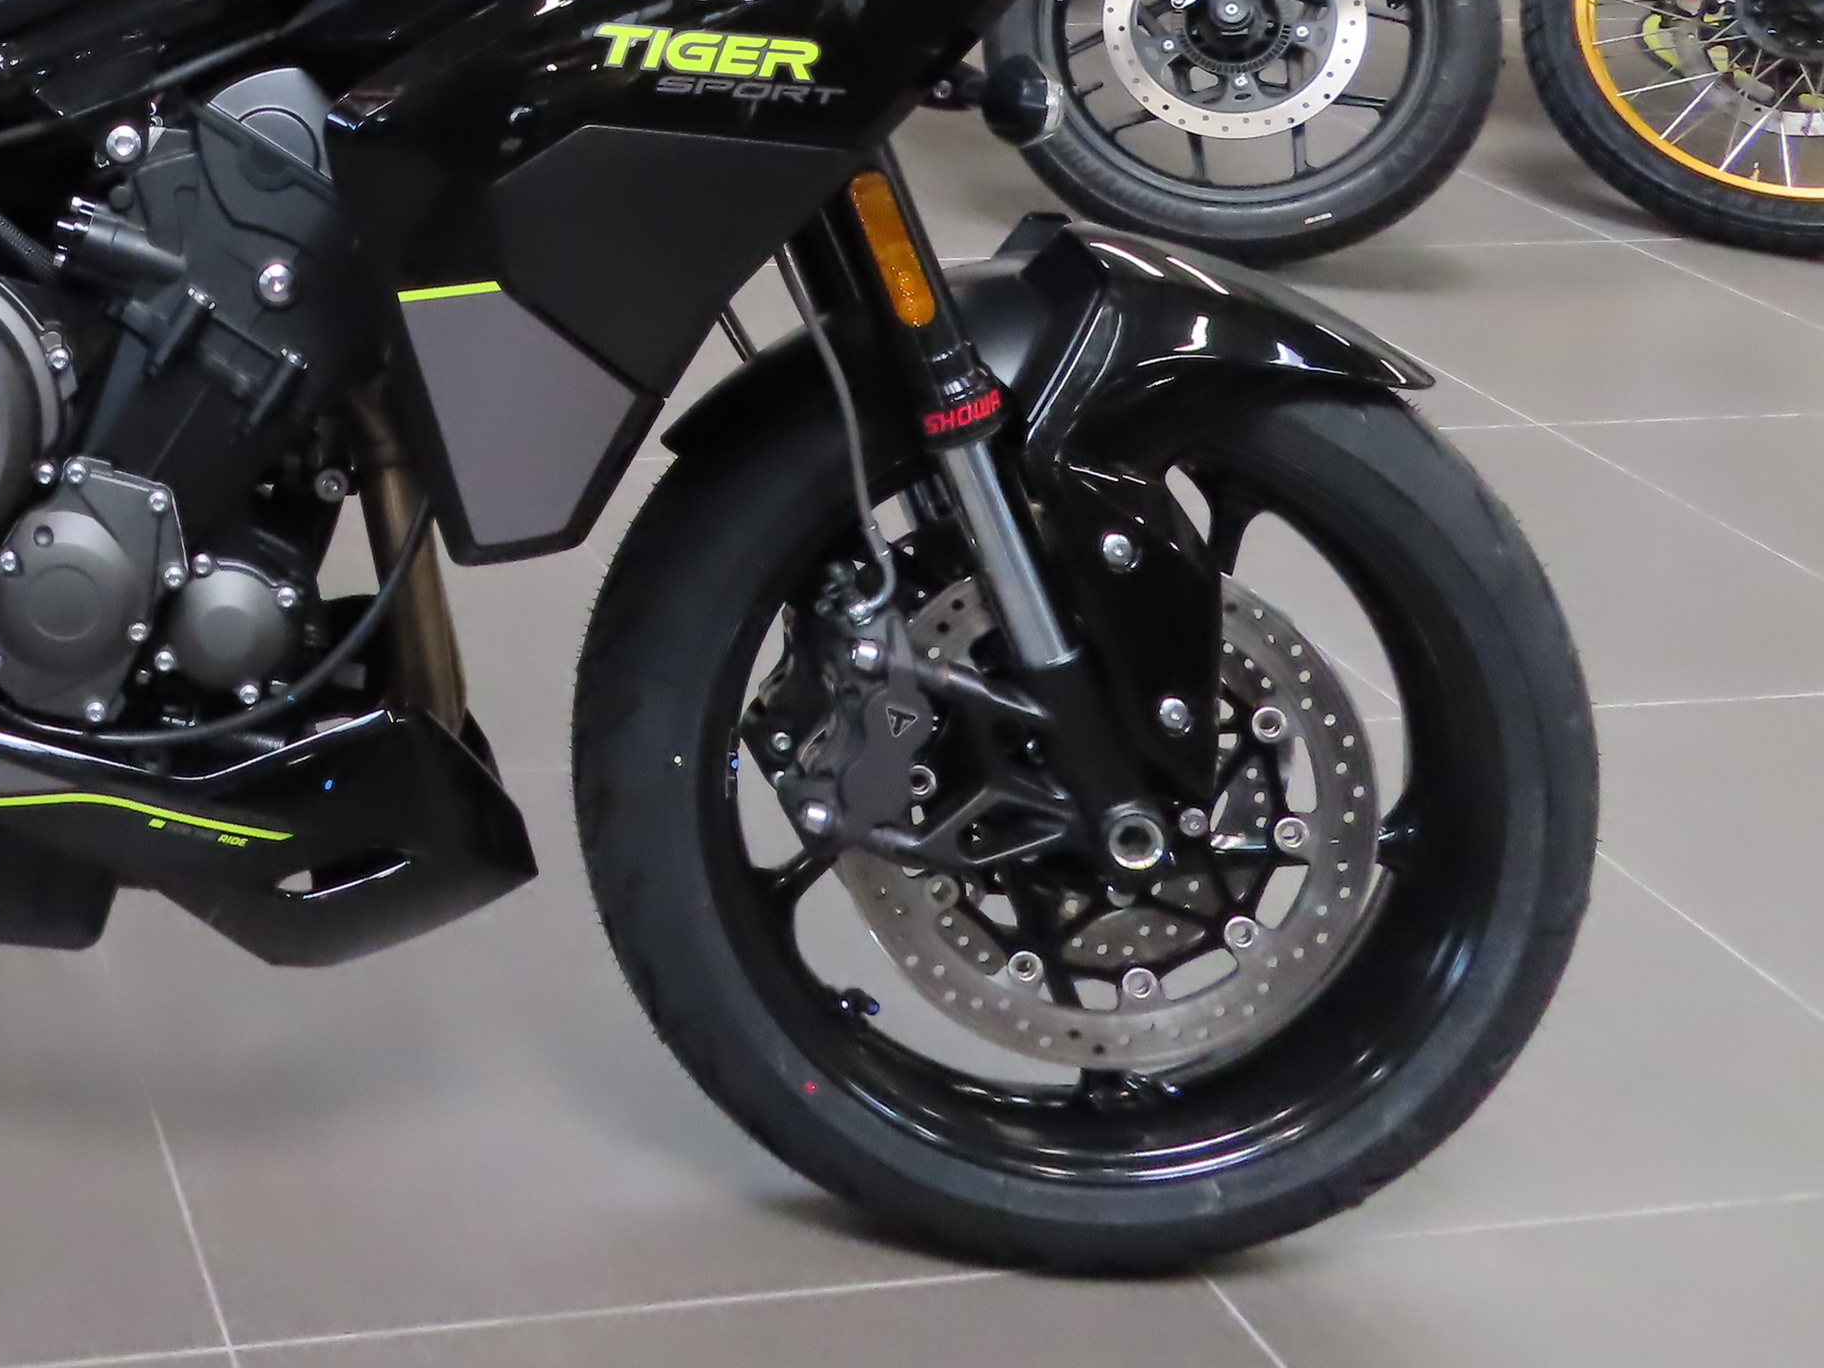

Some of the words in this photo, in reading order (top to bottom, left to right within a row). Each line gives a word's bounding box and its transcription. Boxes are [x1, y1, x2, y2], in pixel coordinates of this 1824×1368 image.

[594, 23, 821, 82] TIGER
[656, 75, 847, 104] SPORT
[923, 389, 1002, 435] SHOWA
